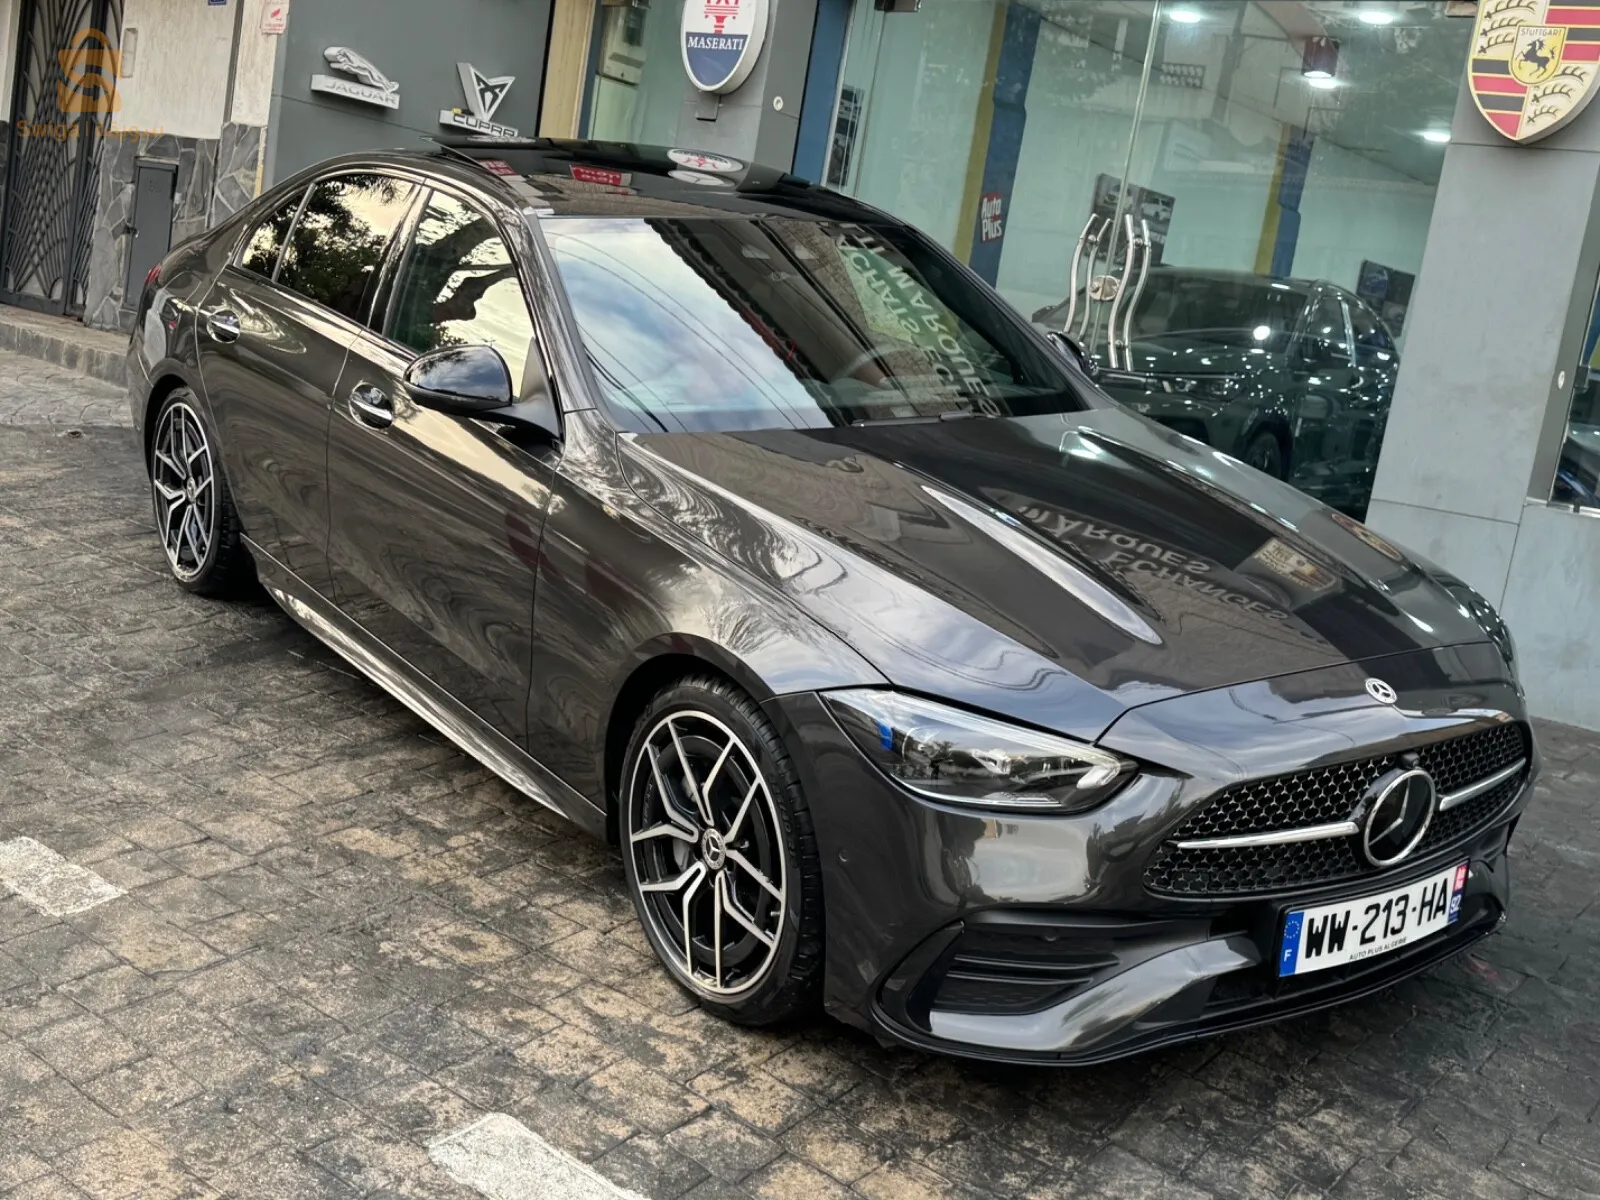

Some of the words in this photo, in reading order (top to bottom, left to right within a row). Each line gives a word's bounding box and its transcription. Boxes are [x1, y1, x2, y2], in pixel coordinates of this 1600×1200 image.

[687, 36, 745, 50] MASERATI
[1520, 28, 1562, 36] STUTTGART
[324, 80, 398, 104] JAGUAR
[452, 113, 516, 137] CUPRA
[981, 197, 1002, 220] Auto
[982, 219, 1003, 241] Plus
[1304, 877, 1449, 959] WW-213-HA
[1283, 949, 1293, 962] F
[1349, 950, 1367, 960] AUTO
